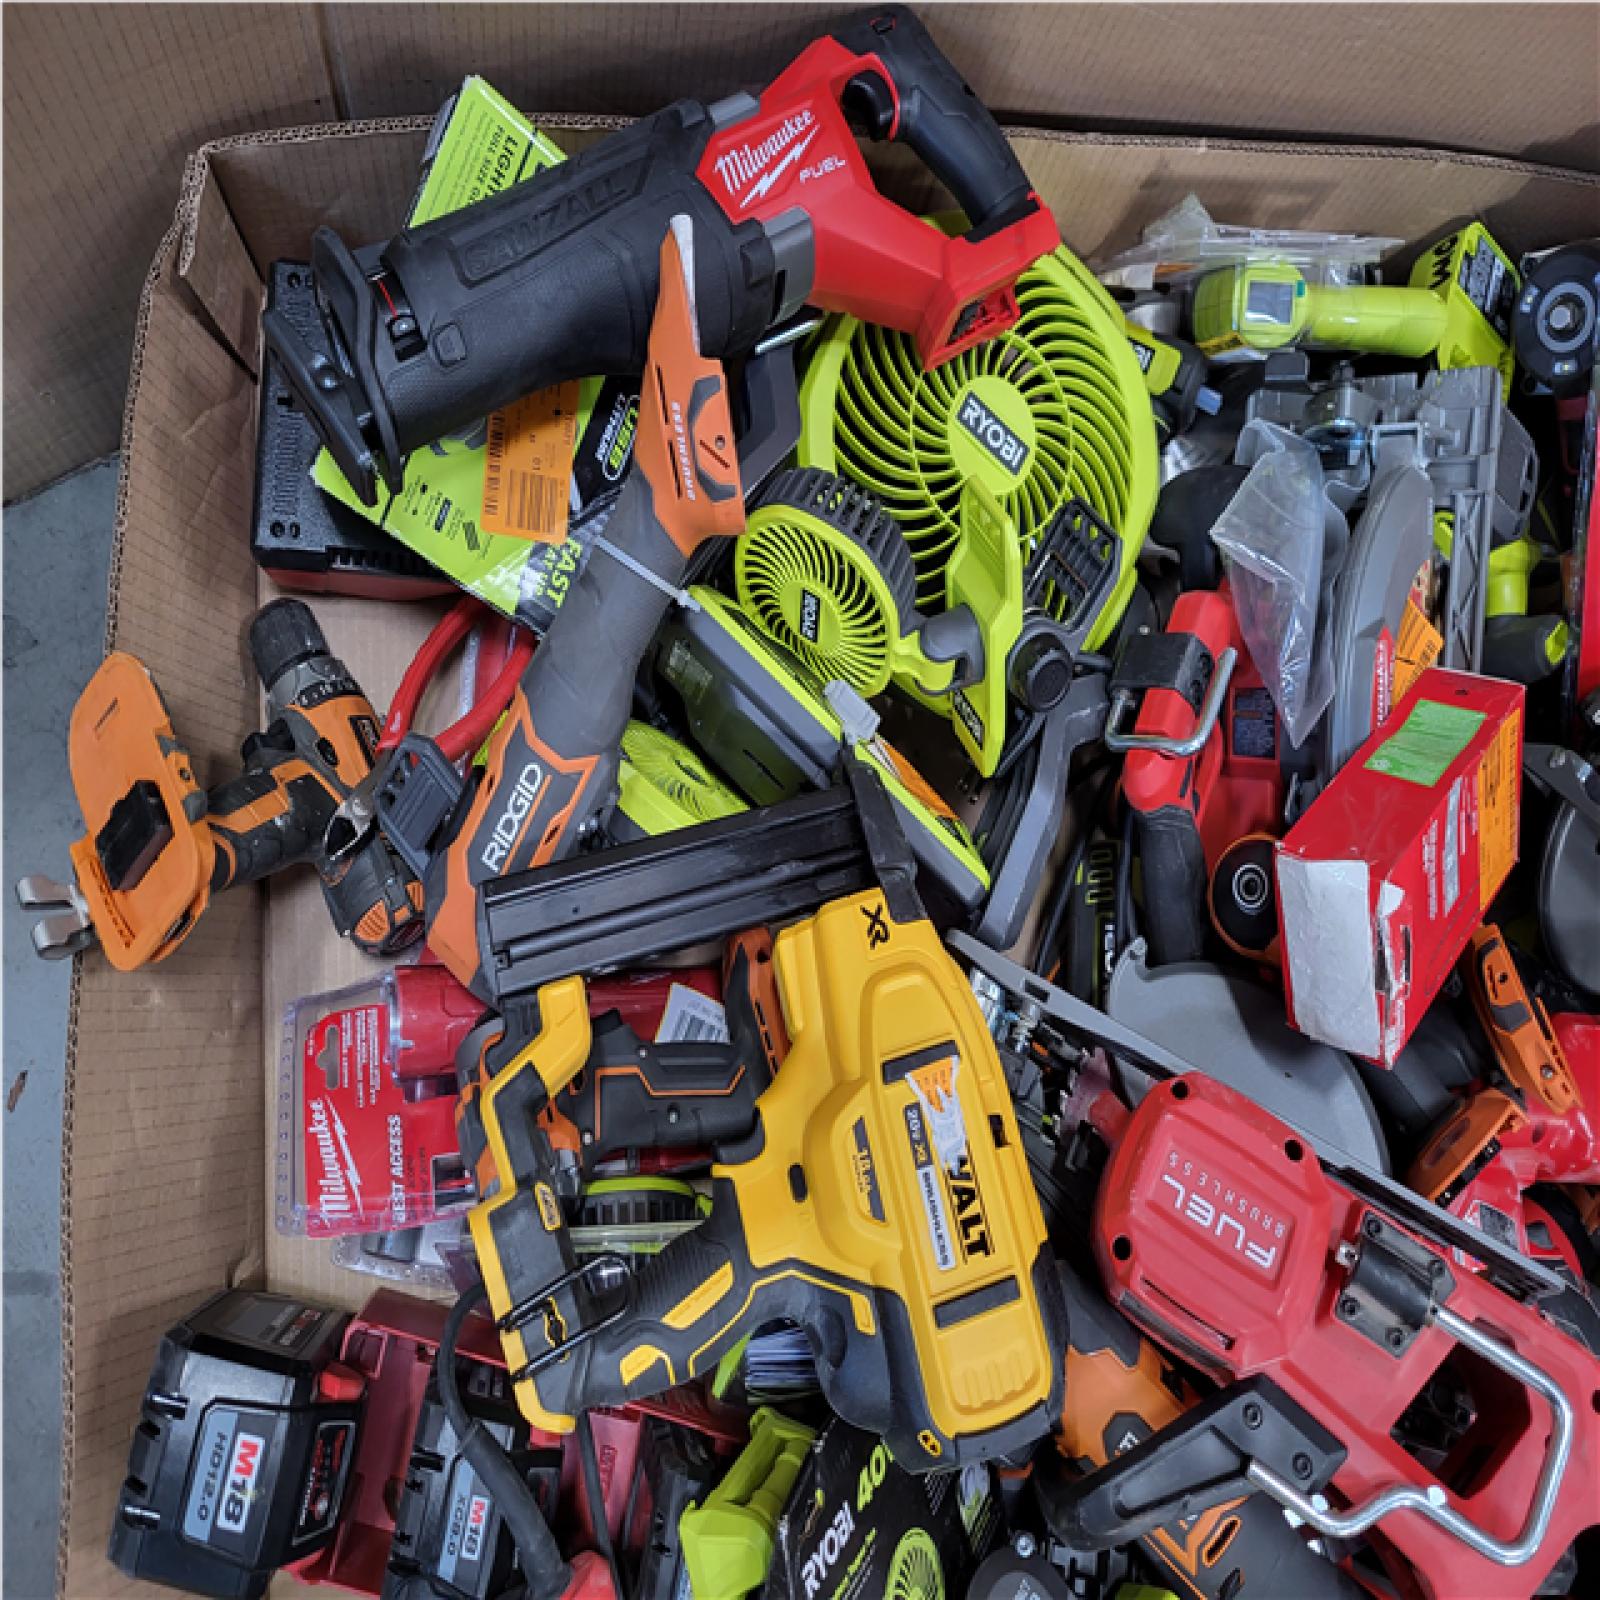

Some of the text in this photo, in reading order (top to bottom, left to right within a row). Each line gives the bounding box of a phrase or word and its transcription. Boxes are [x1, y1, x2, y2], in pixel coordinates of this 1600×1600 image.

[714, 108, 817, 196] Milwaukee
[799, 155, 847, 184] FUEL
[464, 178, 630, 277] SAWZALL
[961, 397, 1025, 471] RYOBI
[553, 538, 583, 608] FAST
[480, 763, 545, 872] RIDGID
[861, 905, 890, 949] XR
[306, 1097, 352, 1228] Milwaukee
[387, 1114, 404, 1178] ACCESS
[1162, 1173, 1276, 1268] FUEL
[1169, 1151, 1287, 1239] BRUSHLESS
[226, 1440, 260, 1525] M18
[465, 1500, 488, 1556] M18
[802, 1501, 855, 1598] RYOBI
